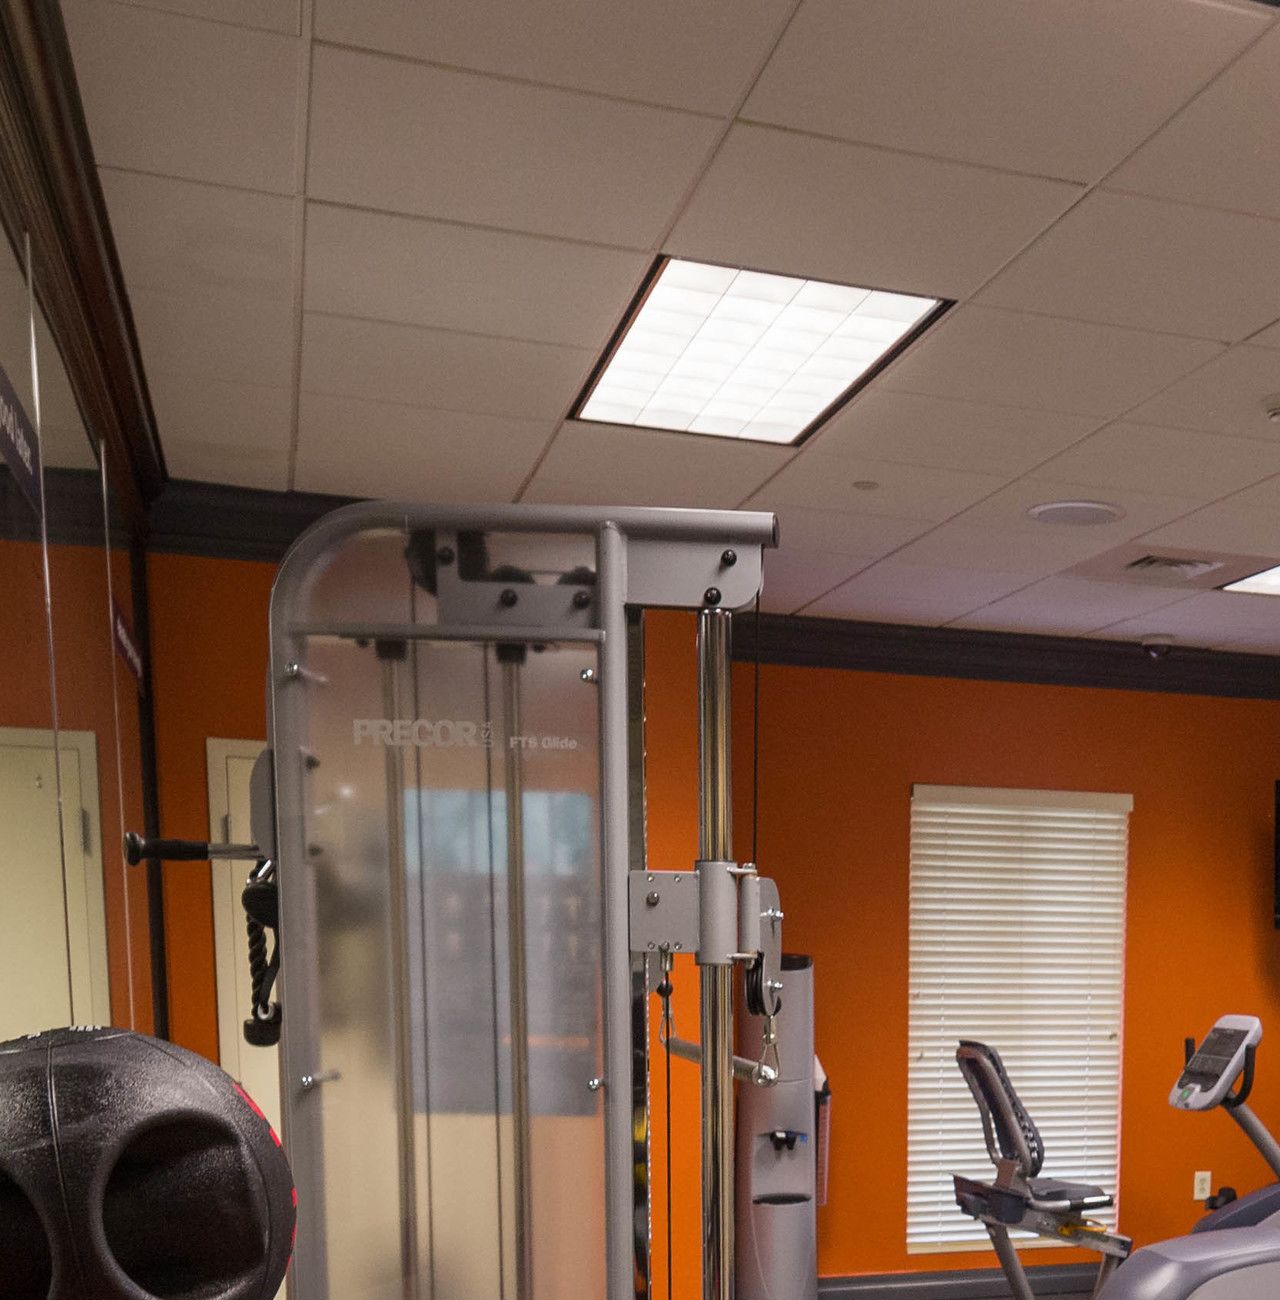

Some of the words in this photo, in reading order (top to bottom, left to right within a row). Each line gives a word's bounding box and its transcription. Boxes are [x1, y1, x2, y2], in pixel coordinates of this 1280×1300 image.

[352, 718, 478, 747] PRECOR
[509, 736, 538, 749] FTS
[541, 736, 578, 750] Glide
